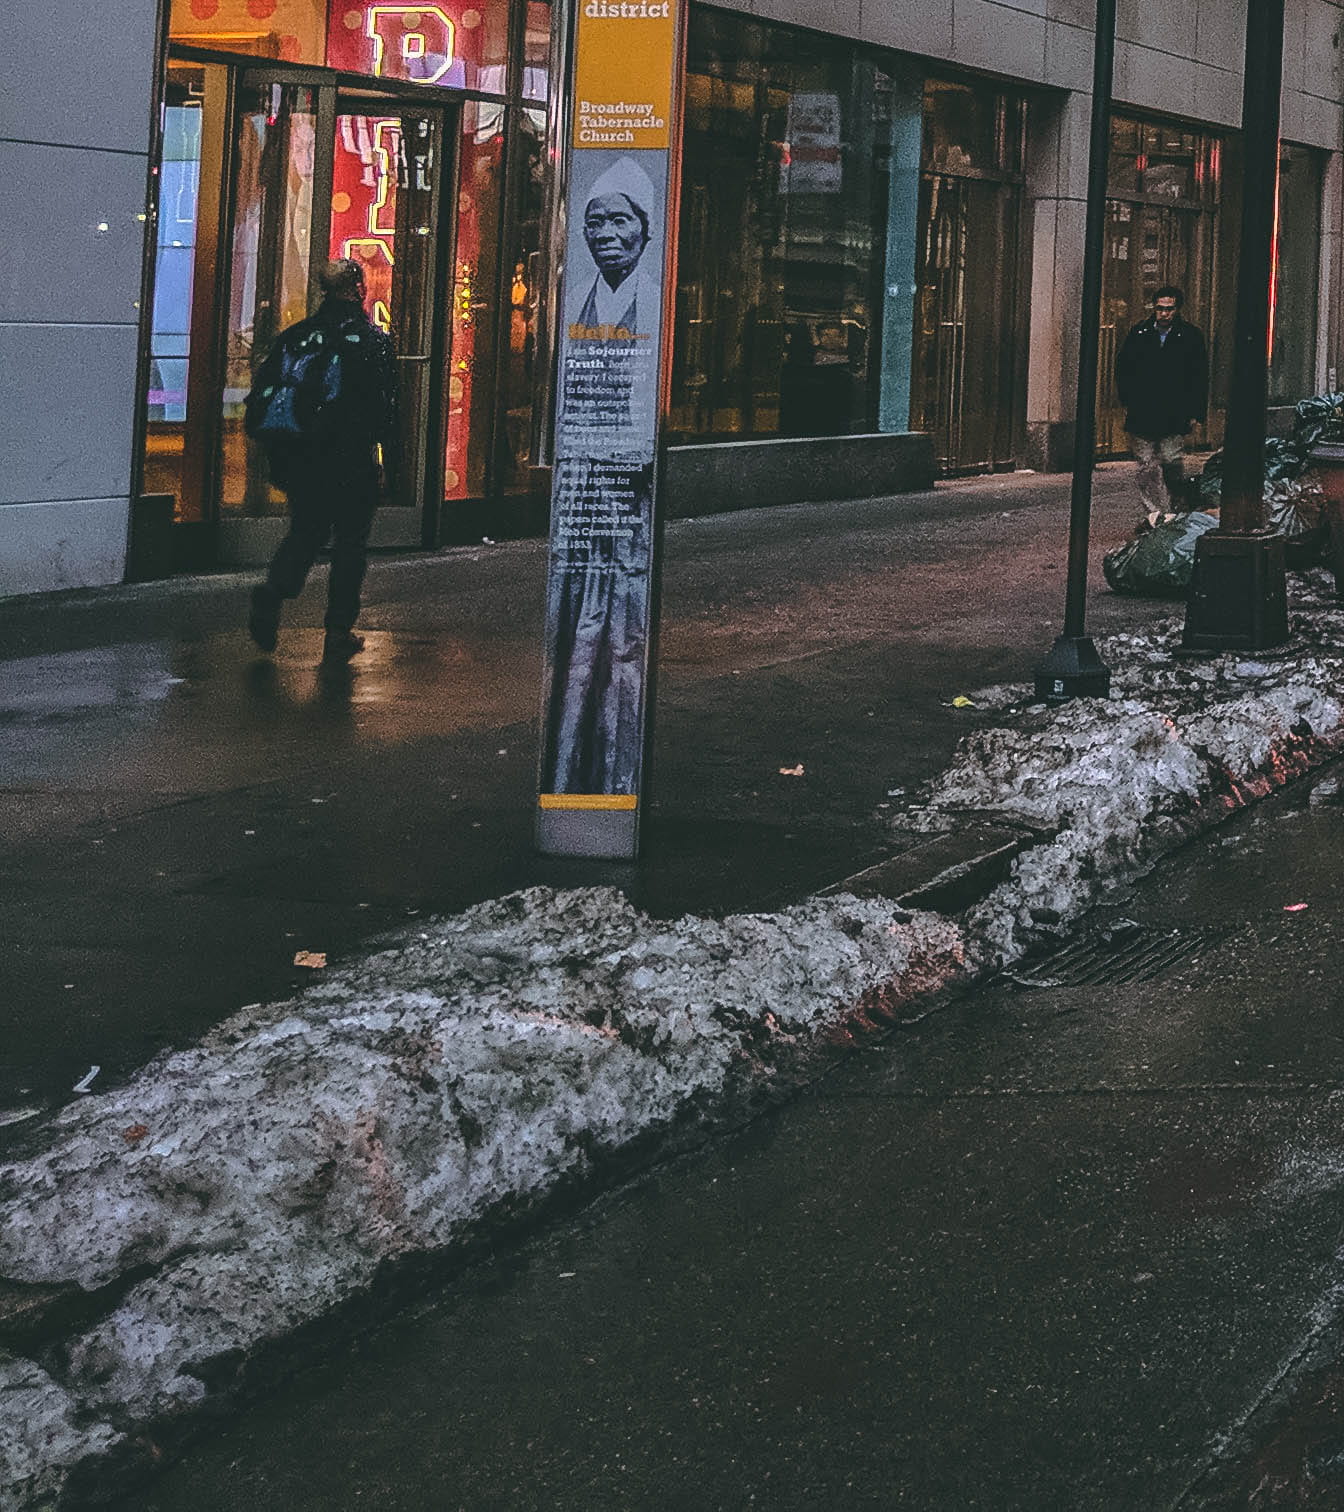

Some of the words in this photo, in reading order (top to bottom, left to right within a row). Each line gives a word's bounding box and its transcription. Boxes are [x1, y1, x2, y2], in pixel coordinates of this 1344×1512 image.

[585, 0, 670, 19] district
[579, 101, 654, 117] Broadway
[579, 115, 664, 129] Tabernacle
[579, 130, 634, 143] Church
[588, 346, 652, 356] Sojourner
[588, 476, 615, 486] rights
[617, 476, 631, 485] for
